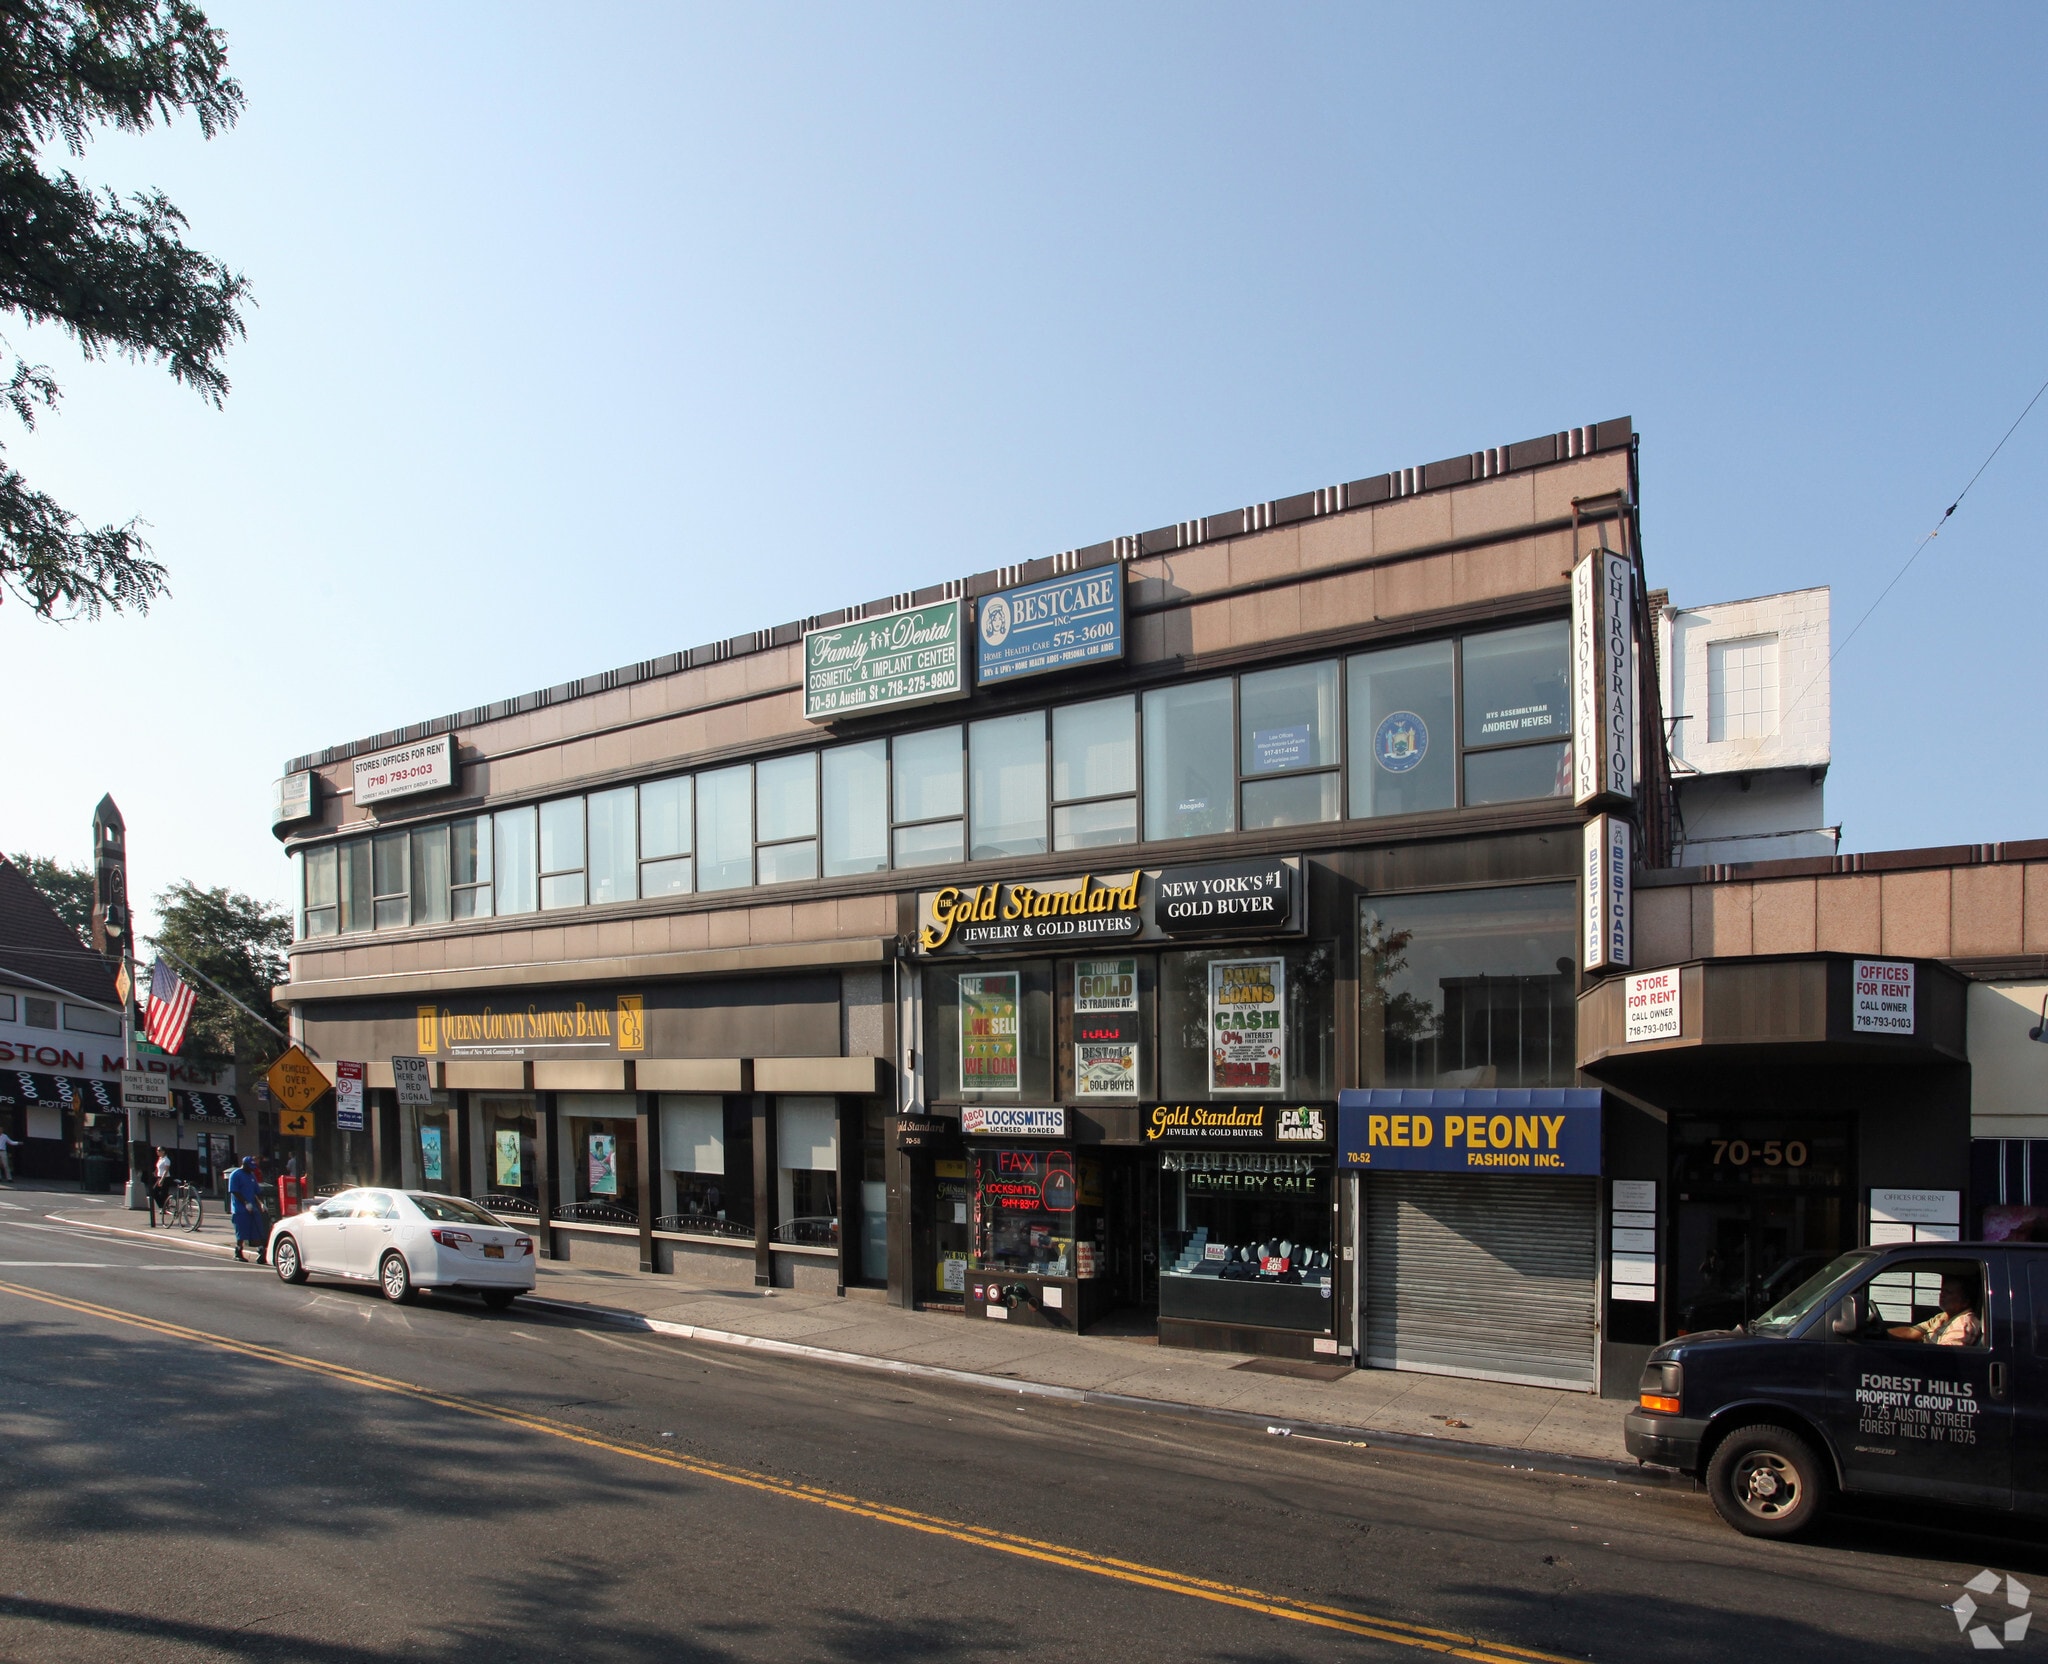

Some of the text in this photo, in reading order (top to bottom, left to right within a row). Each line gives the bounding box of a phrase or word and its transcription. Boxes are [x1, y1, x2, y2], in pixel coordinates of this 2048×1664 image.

[1012, 578, 1114, 625] BESTCARE
[1054, 615, 1071, 627] INC.
[811, 612, 954, 671] Family Dental
[1053, 621, 1114, 647] 575-3600
[1015, 642, 1114, 670] HOME HEALTH AIDES PERSONAL CARE AIDES
[809, 647, 955, 690] COSMETIC & IMPLANT CENTER
[1609, 560, 1626, 793] CHIROPRACTOR
[1579, 563, 1591, 796] CHIROPRACTOR
[809, 669, 955, 712] 70-50 Austin St 718-275-9800
[1486, 704, 1548, 719] NYS ASSEMBLYMAN
[1482, 714, 1552, 733] ANDREW HEVESI
[355, 743, 445, 773] STORES/OFFICES FOR RENT
[367, 763, 433, 788] (718) 793-0103
[391, 785, 412, 793] PROPERTY
[1161, 870, 1282, 898] NEW YORK'S #1
[926, 869, 1142, 949] Gold Standard
[1167, 896, 1274, 918] GOLD BUYER
[1589, 848, 1599, 962] BESTCARE
[1612, 846, 1625, 962] BESTCARE
[964, 917, 1132, 941] JEWELRY & GOLD BUYERS
[1090, 961, 1120, 975] TODAY
[1223, 967, 1271, 985] PAWN
[1860, 965, 1909, 981] OFFICES
[963, 978, 982, 995] WE
[1079, 974, 1133, 999] GOLD
[1636, 975, 1668, 992] STORE
[1856, 982, 1911, 998] FOR RENT
[1219, 984, 1275, 1005] LOANS
[1628, 989, 1677, 1008] FOR RENT
[1080, 998, 1133, 1009] IS TRADING AT:
[1860, 1000, 1907, 1013] CALL OWNER
[1215, 1009, 1280, 1031] CA$H
[1631, 1008, 1674, 1022] CALL OWNER
[1857, 1015, 1911, 1028] 718-793-0103
[441, 1001, 611, 1049] QUEENS COUNTY SAVINGS BANK
[991, 1017, 1017, 1035] SELL
[1628, 1020, 1677, 1036] 718-793-0103
[1221, 1030, 1243, 1045] 0%
[492, 1048, 514, 1056] Community
[1082, 1048, 1109, 1059] BEST
[281, 1063, 311, 1075] VEHICLES
[395, 1059, 425, 1072] STOP
[965, 1056, 1017, 1075] WE LOAN
[124, 1075, 165, 1085] DON'T BLOCK
[285, 1076, 307, 1085] OVER
[397, 1073, 427, 1081] HERE ON
[1090, 1079, 1135, 1091] GOLD BUYER
[132, 1083, 143, 1091] THE
[406, 1083, 421, 1091] RED
[400, 1092, 429, 1101] SIGNAL
[963, 1109, 984, 1123] ABCO
[985, 1110, 1063, 1126] LOCKSMITHS
[1150, 1105, 1264, 1139] Gold Standard
[908, 1121, 945, 1133] Standard
[1166, 1128, 1263, 1137] JEWELRY & GOLD BUYERS
[1278, 1123, 1324, 1140] LOANS
[1368, 1115, 1566, 1149] RED PEONY
[1347, 1152, 1371, 1163] 70-52
[1467, 1153, 1565, 1167] FASHION INC.
[1711, 1140, 1807, 1166] 70-50
[1000, 1152, 1035, 1172] FAX
[986, 1183, 1037, 1196] LOCKSMITH
[1188, 1173, 1317, 1193] JEWELRY SALE
[1884, 1193, 1912, 1201] OFFICES
[1927, 1194, 1945, 1202] RENT
[1266, 1262, 1282, 1271] 50%
[1861, 1373, 1973, 1398] FOREST HILLS
[1855, 1388, 1980, 1414] PROPERTY GROUP LTD.
[1862, 1404, 1974, 1429] 71-25 AUSTIN STREET
[1859, 1419, 1976, 1445] FOREST HILLS NY 11375
